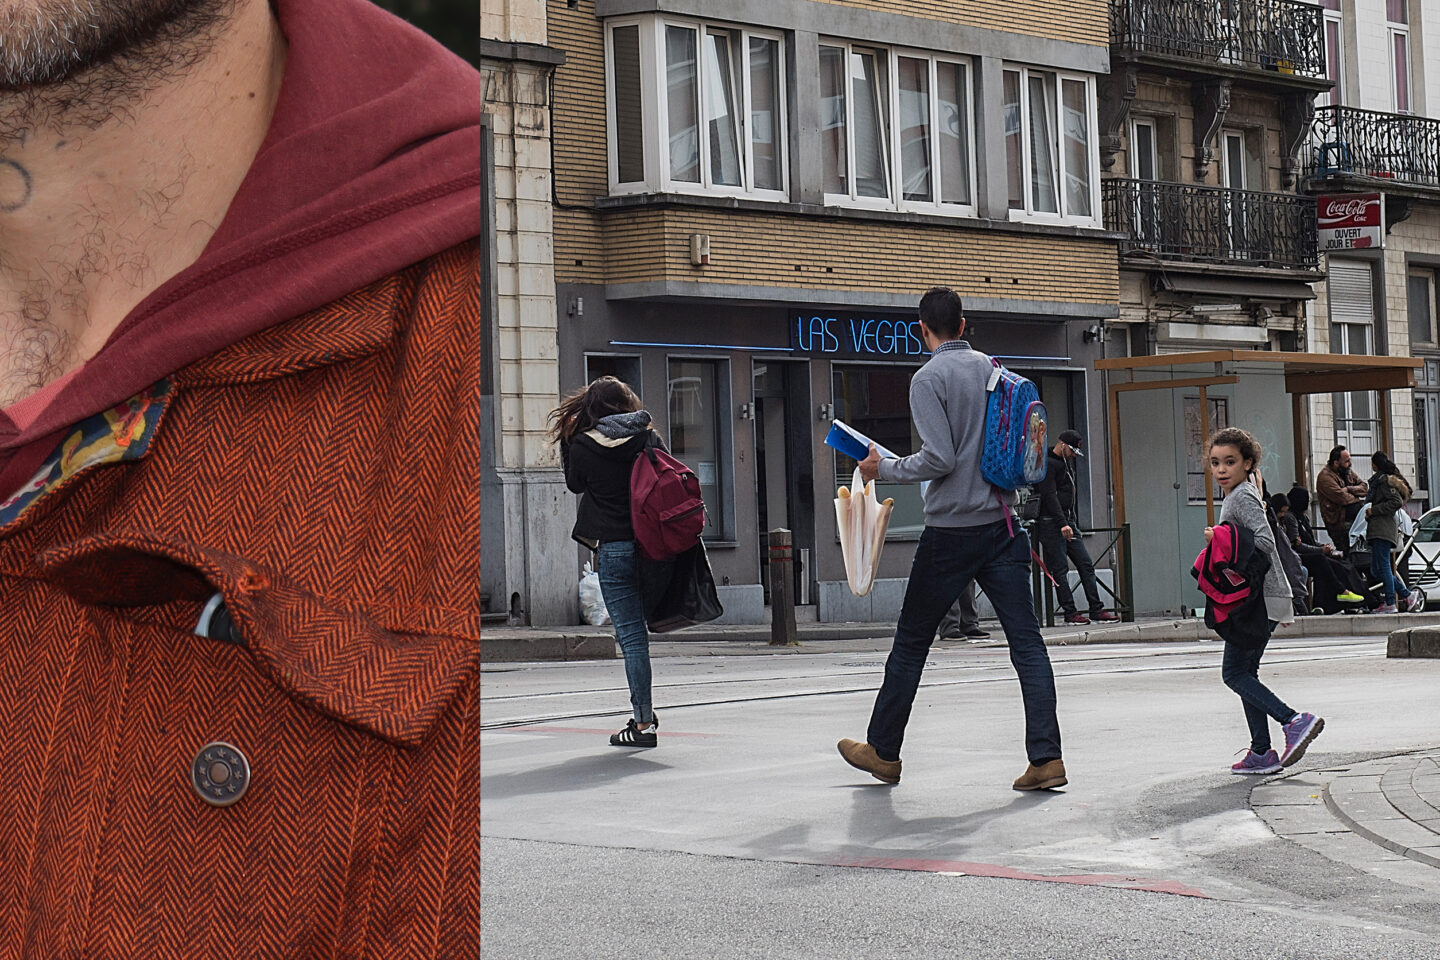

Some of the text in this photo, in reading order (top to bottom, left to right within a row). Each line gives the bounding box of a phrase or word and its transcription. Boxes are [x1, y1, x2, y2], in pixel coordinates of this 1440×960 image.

[1326, 200, 1366, 216] Coca-Cola
[1335, 228, 1361, 239] OUVERT
[1325, 239, 1354, 249] JOUR ET
[798, 316, 922, 355] LAS VEGAS
